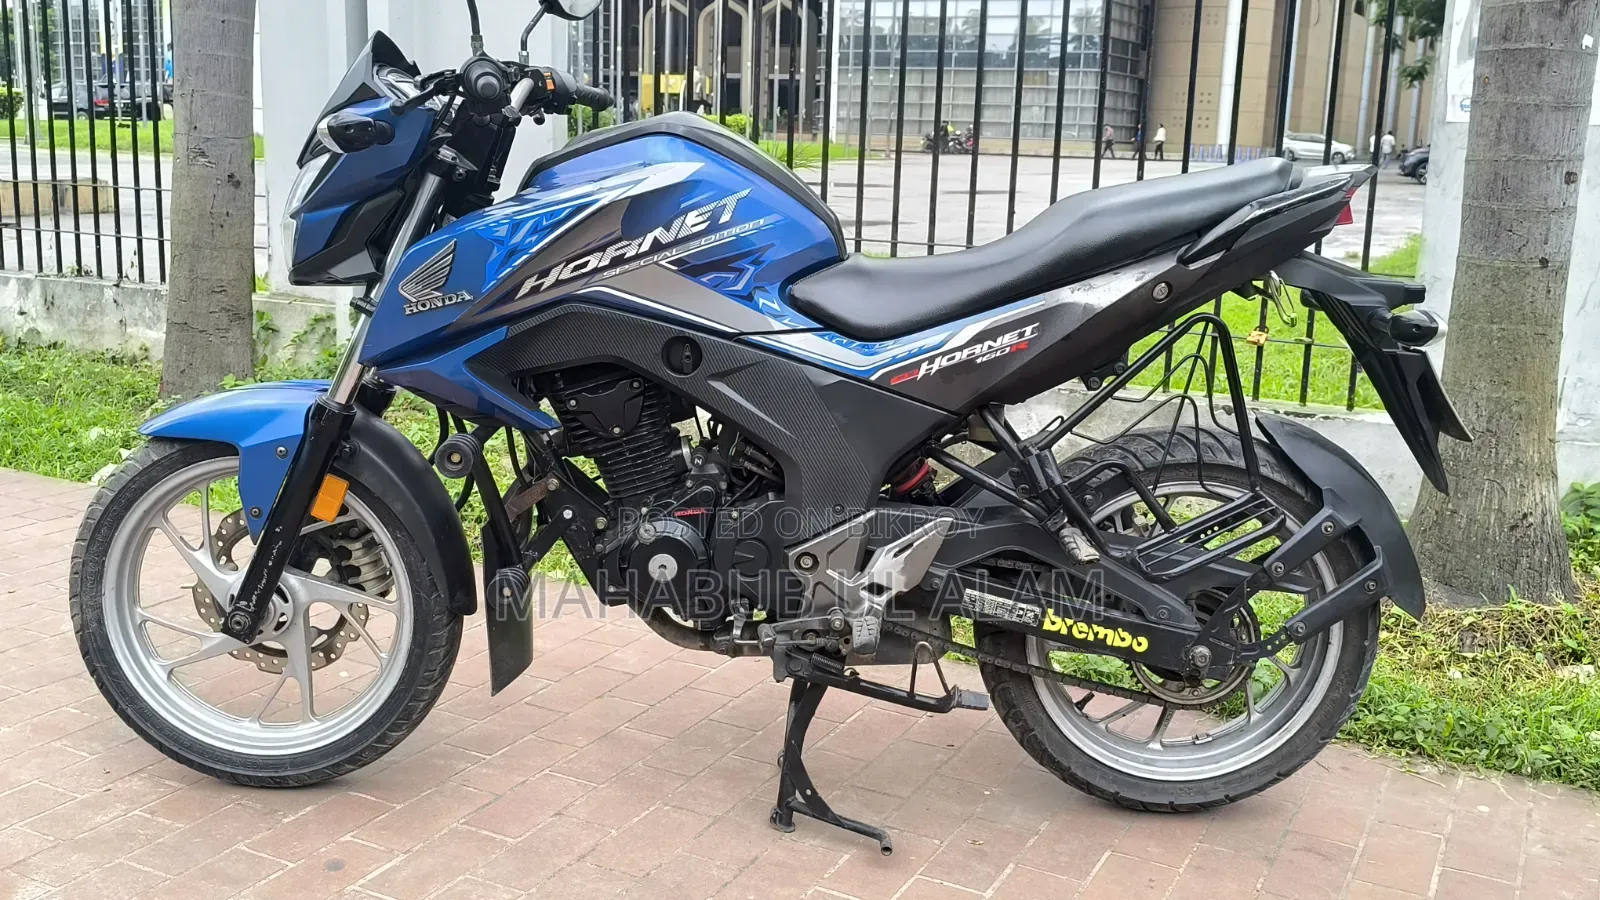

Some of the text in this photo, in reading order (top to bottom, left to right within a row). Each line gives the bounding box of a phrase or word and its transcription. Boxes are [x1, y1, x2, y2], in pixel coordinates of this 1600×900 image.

[515, 187, 754, 300] HORNET
[602, 218, 766, 279] SPECIAL EDITION
[403, 289, 474, 315] HONDA
[916, 322, 1040, 380] HORNET
[974, 340, 1030, 364] 160R
[673, 508, 708, 517] HONDA
[1042, 608, 1150, 653] brembo
